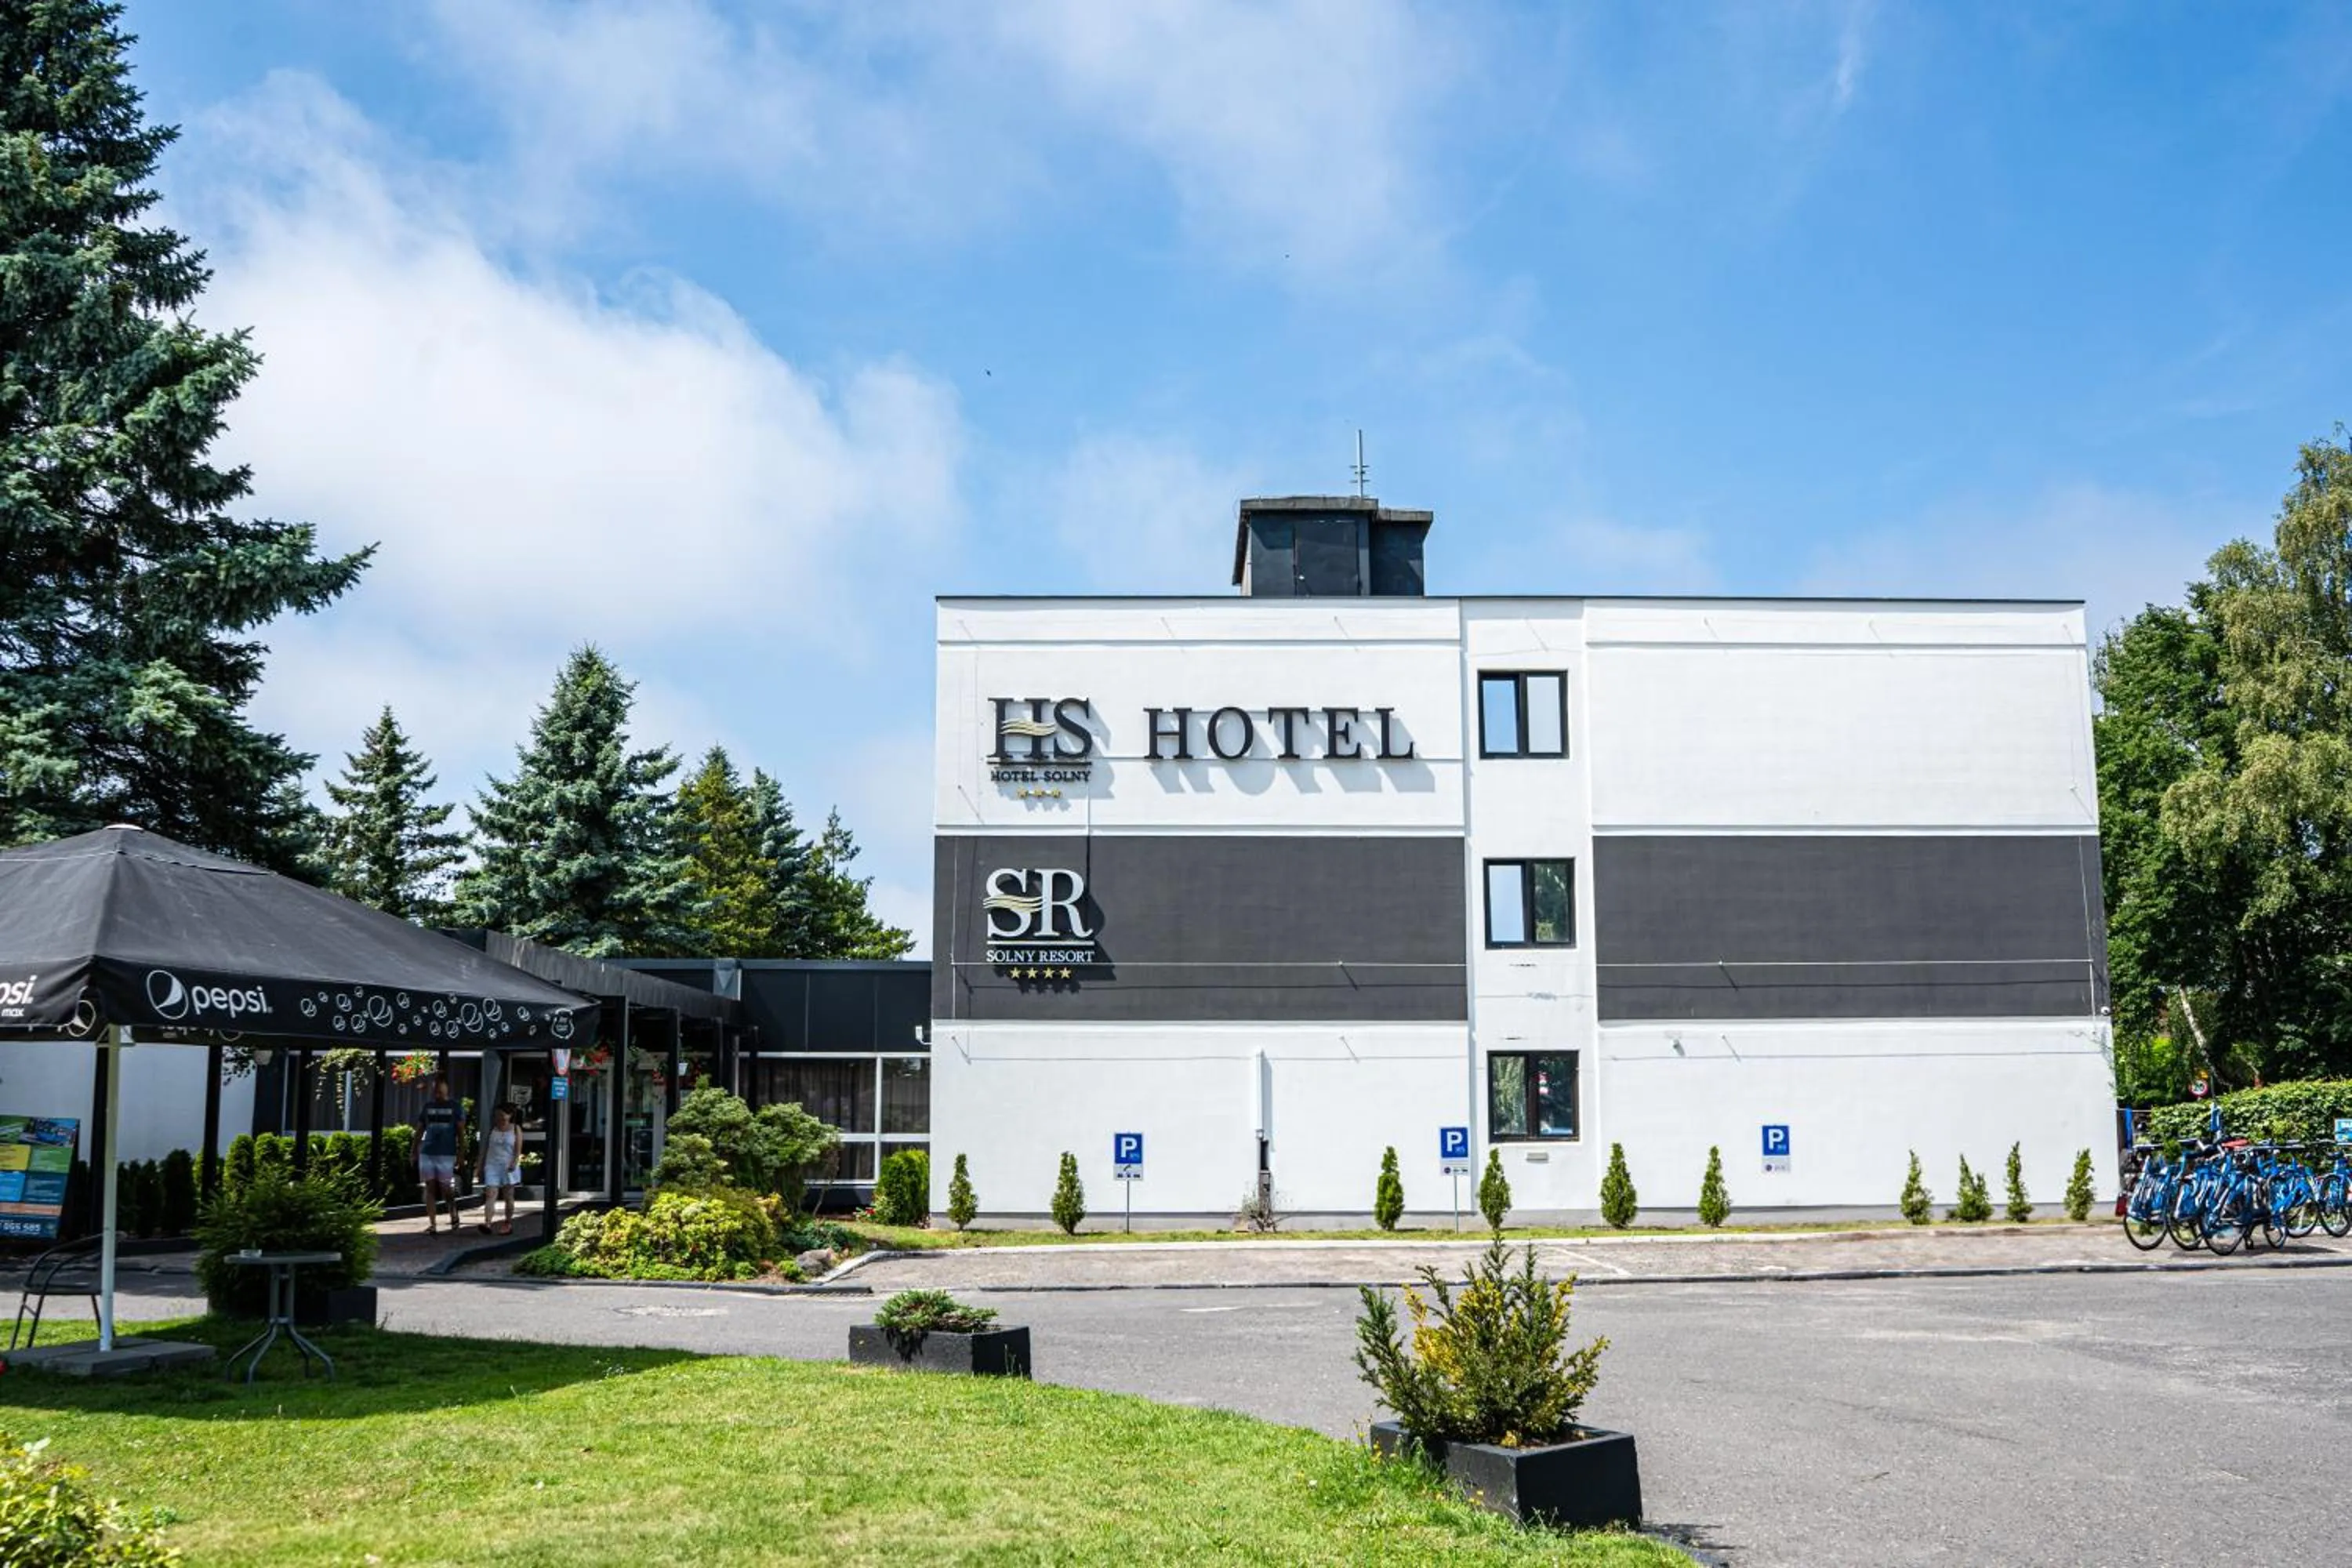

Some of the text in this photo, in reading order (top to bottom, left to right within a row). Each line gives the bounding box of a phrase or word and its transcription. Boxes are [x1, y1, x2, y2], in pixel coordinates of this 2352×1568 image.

[986, 697, 1093, 760] HS
[1143, 706, 1414, 760] HOTEL
[990, 771, 1091, 782] HOTEL SOLNY
[985, 868, 1094, 938] SR
[986, 950, 1094, 962] SOLNY RESORT
[191, 985, 268, 1018] pepsi
[2, 1008, 25, 1017] max
[1121, 1137, 1137, 1158] P
[1446, 1131, 1463, 1152] P
[1768, 1129, 1784, 1150] P
